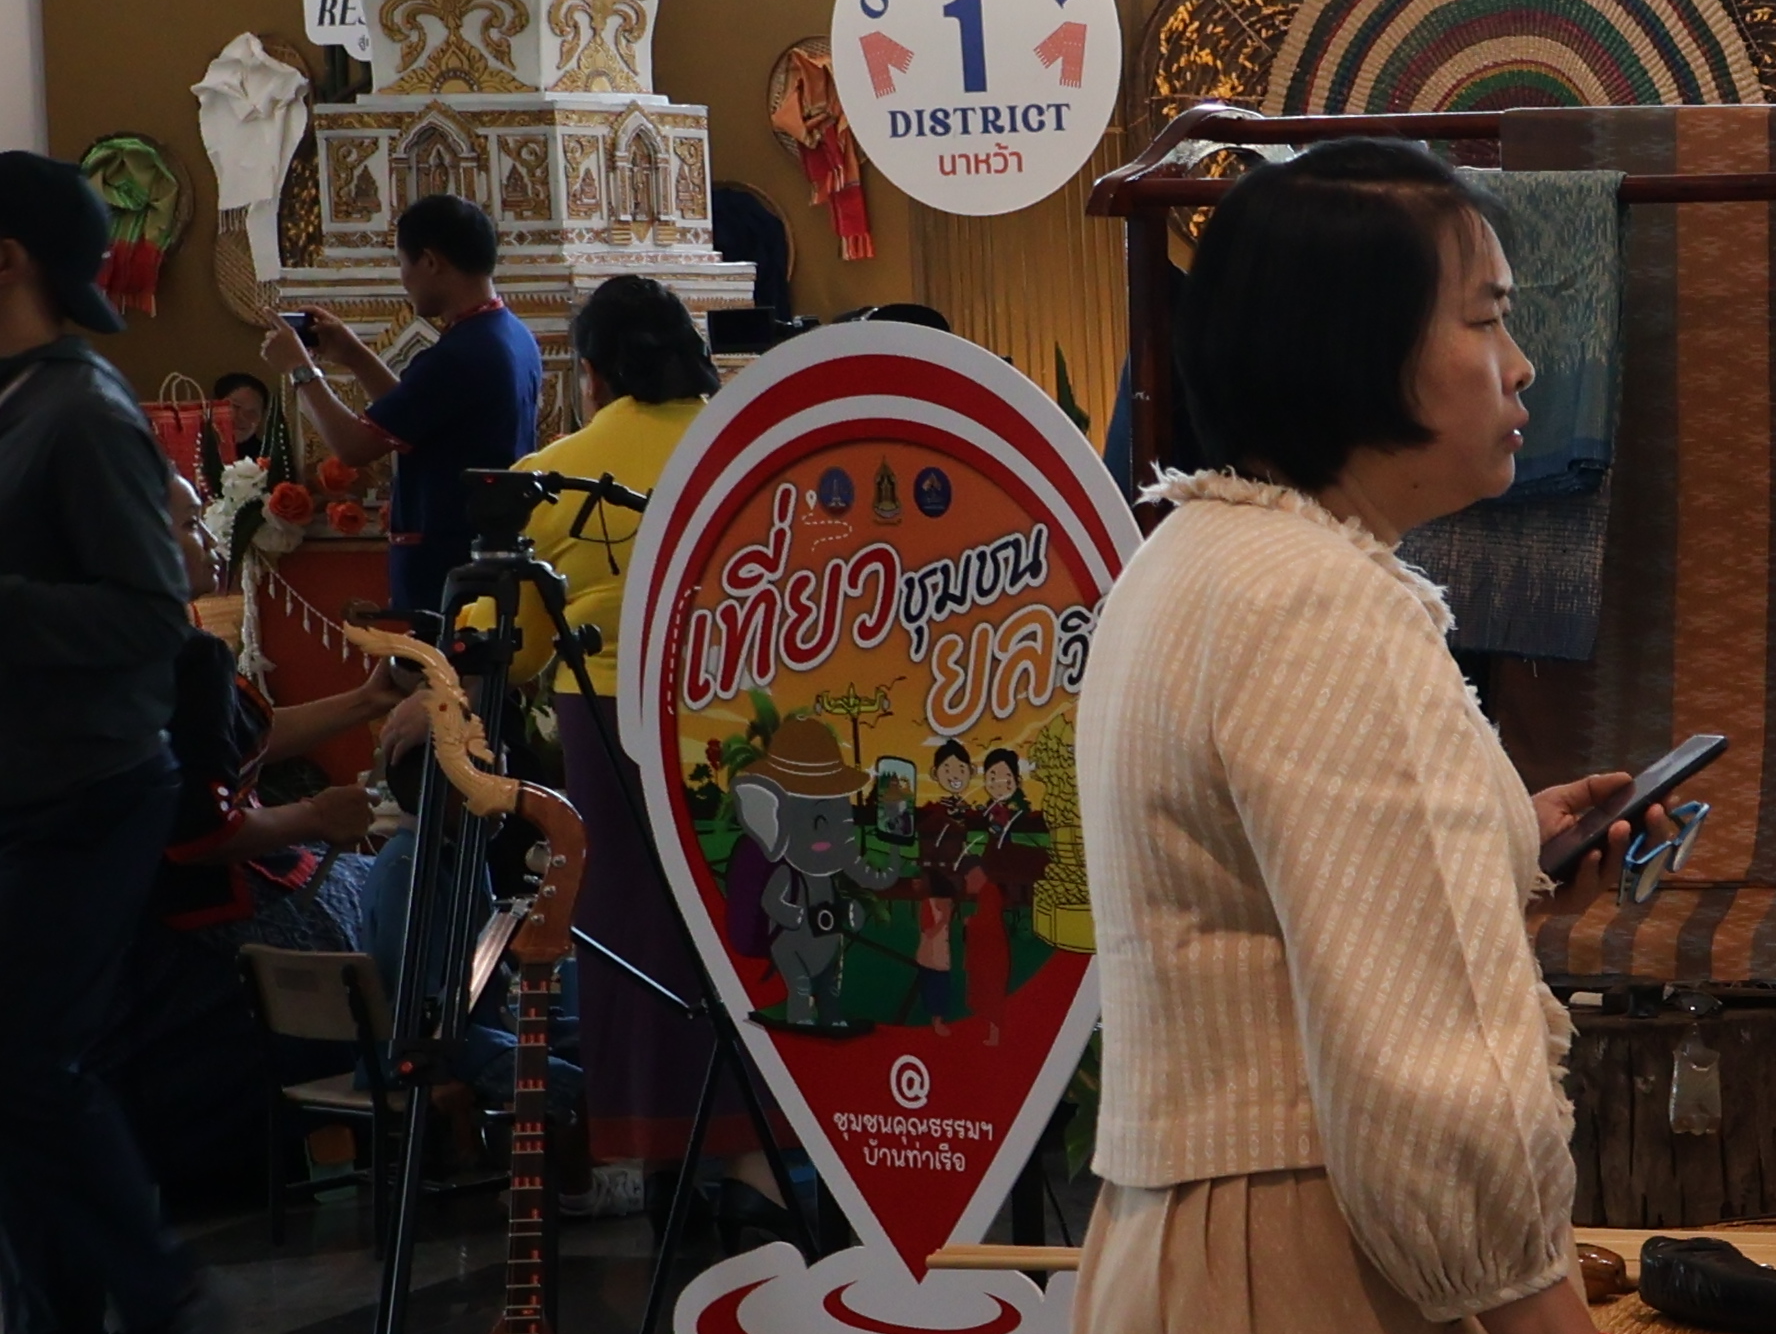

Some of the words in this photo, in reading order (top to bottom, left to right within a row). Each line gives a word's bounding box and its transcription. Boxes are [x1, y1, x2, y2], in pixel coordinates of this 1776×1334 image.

[889, 102, 1072, 139] DISTRICT
[938, 142, 1025, 177] นาหว้า
[832, 1112, 994, 1145] ชุมชนคุณธรรมฯ
[863, 1139, 967, 1173] บ้านท่าเรือ
